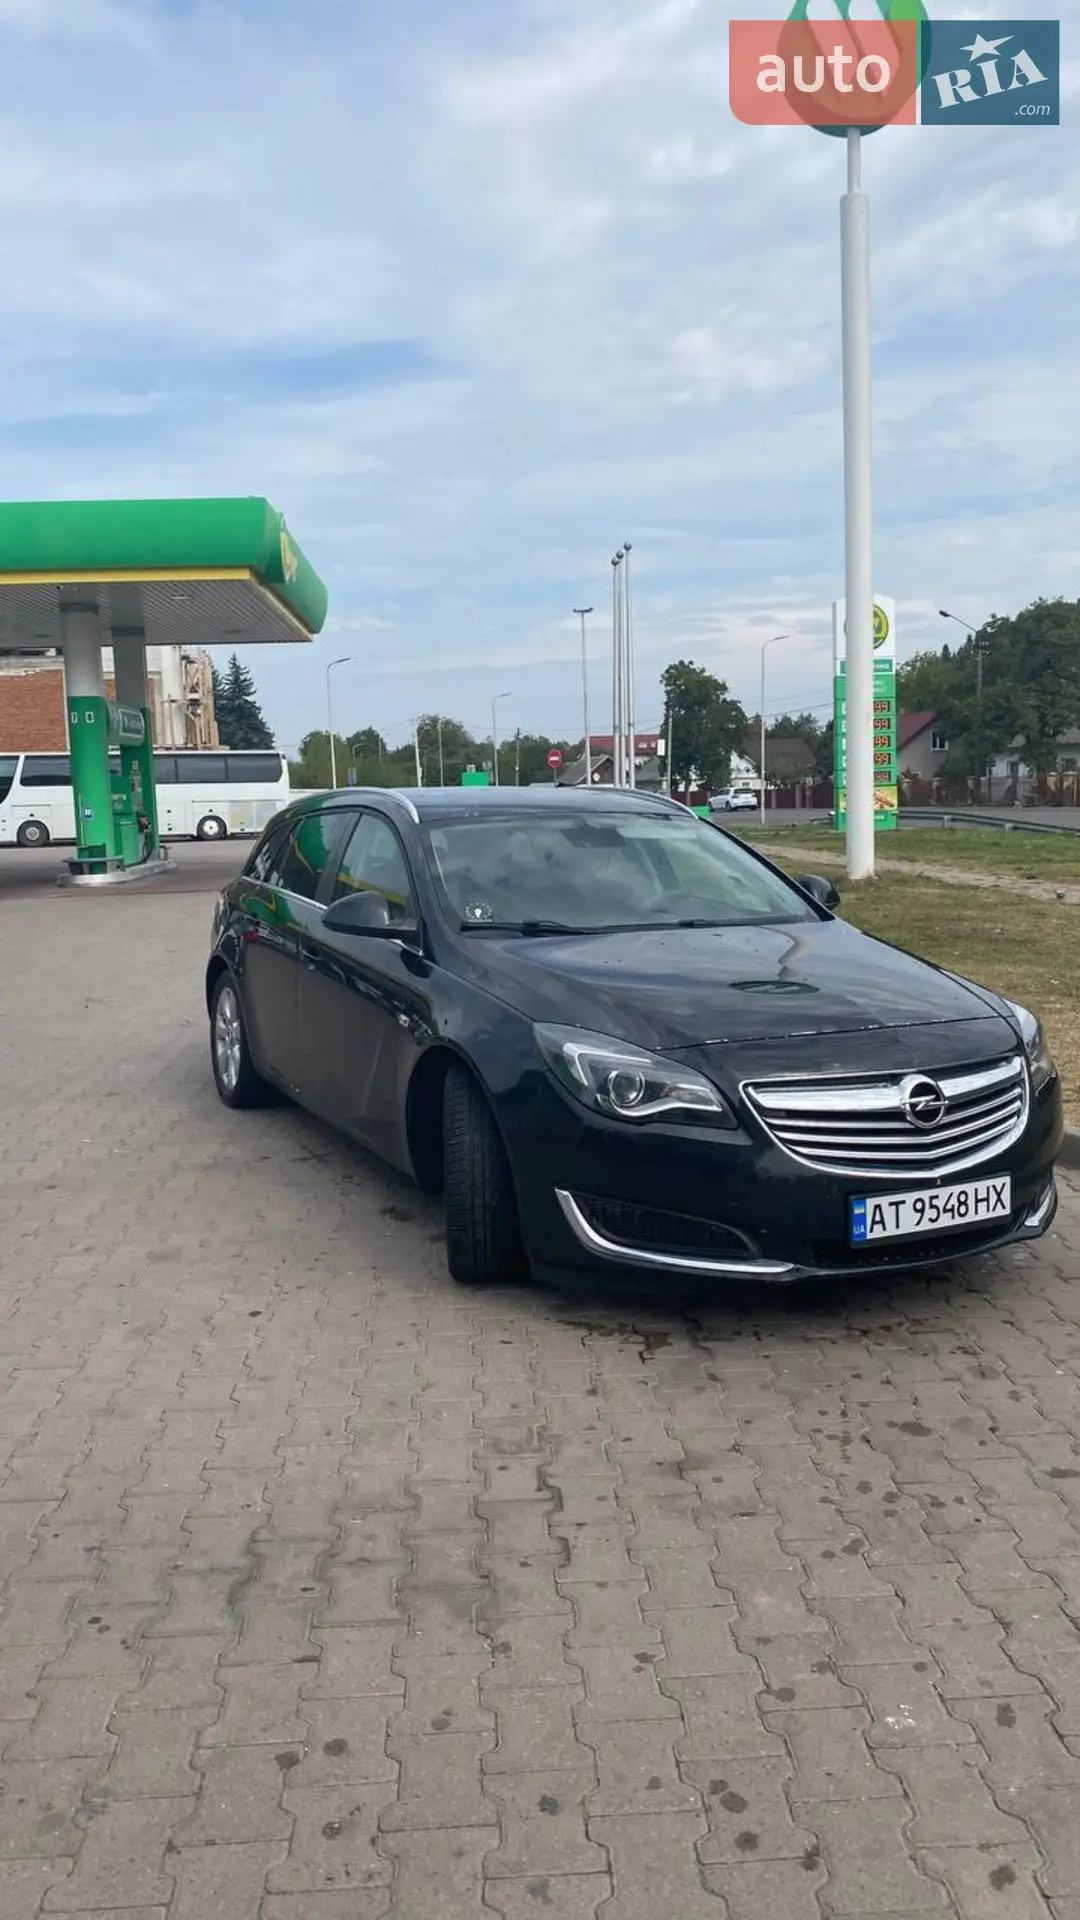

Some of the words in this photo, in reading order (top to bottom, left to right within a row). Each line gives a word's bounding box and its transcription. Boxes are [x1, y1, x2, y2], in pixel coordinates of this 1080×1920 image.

[869, 1201, 906, 1233] AT
[913, 1190, 969, 1226] 9548
[975, 1182, 1007, 1215] HX
[853, 1224, 865, 1235] UA
